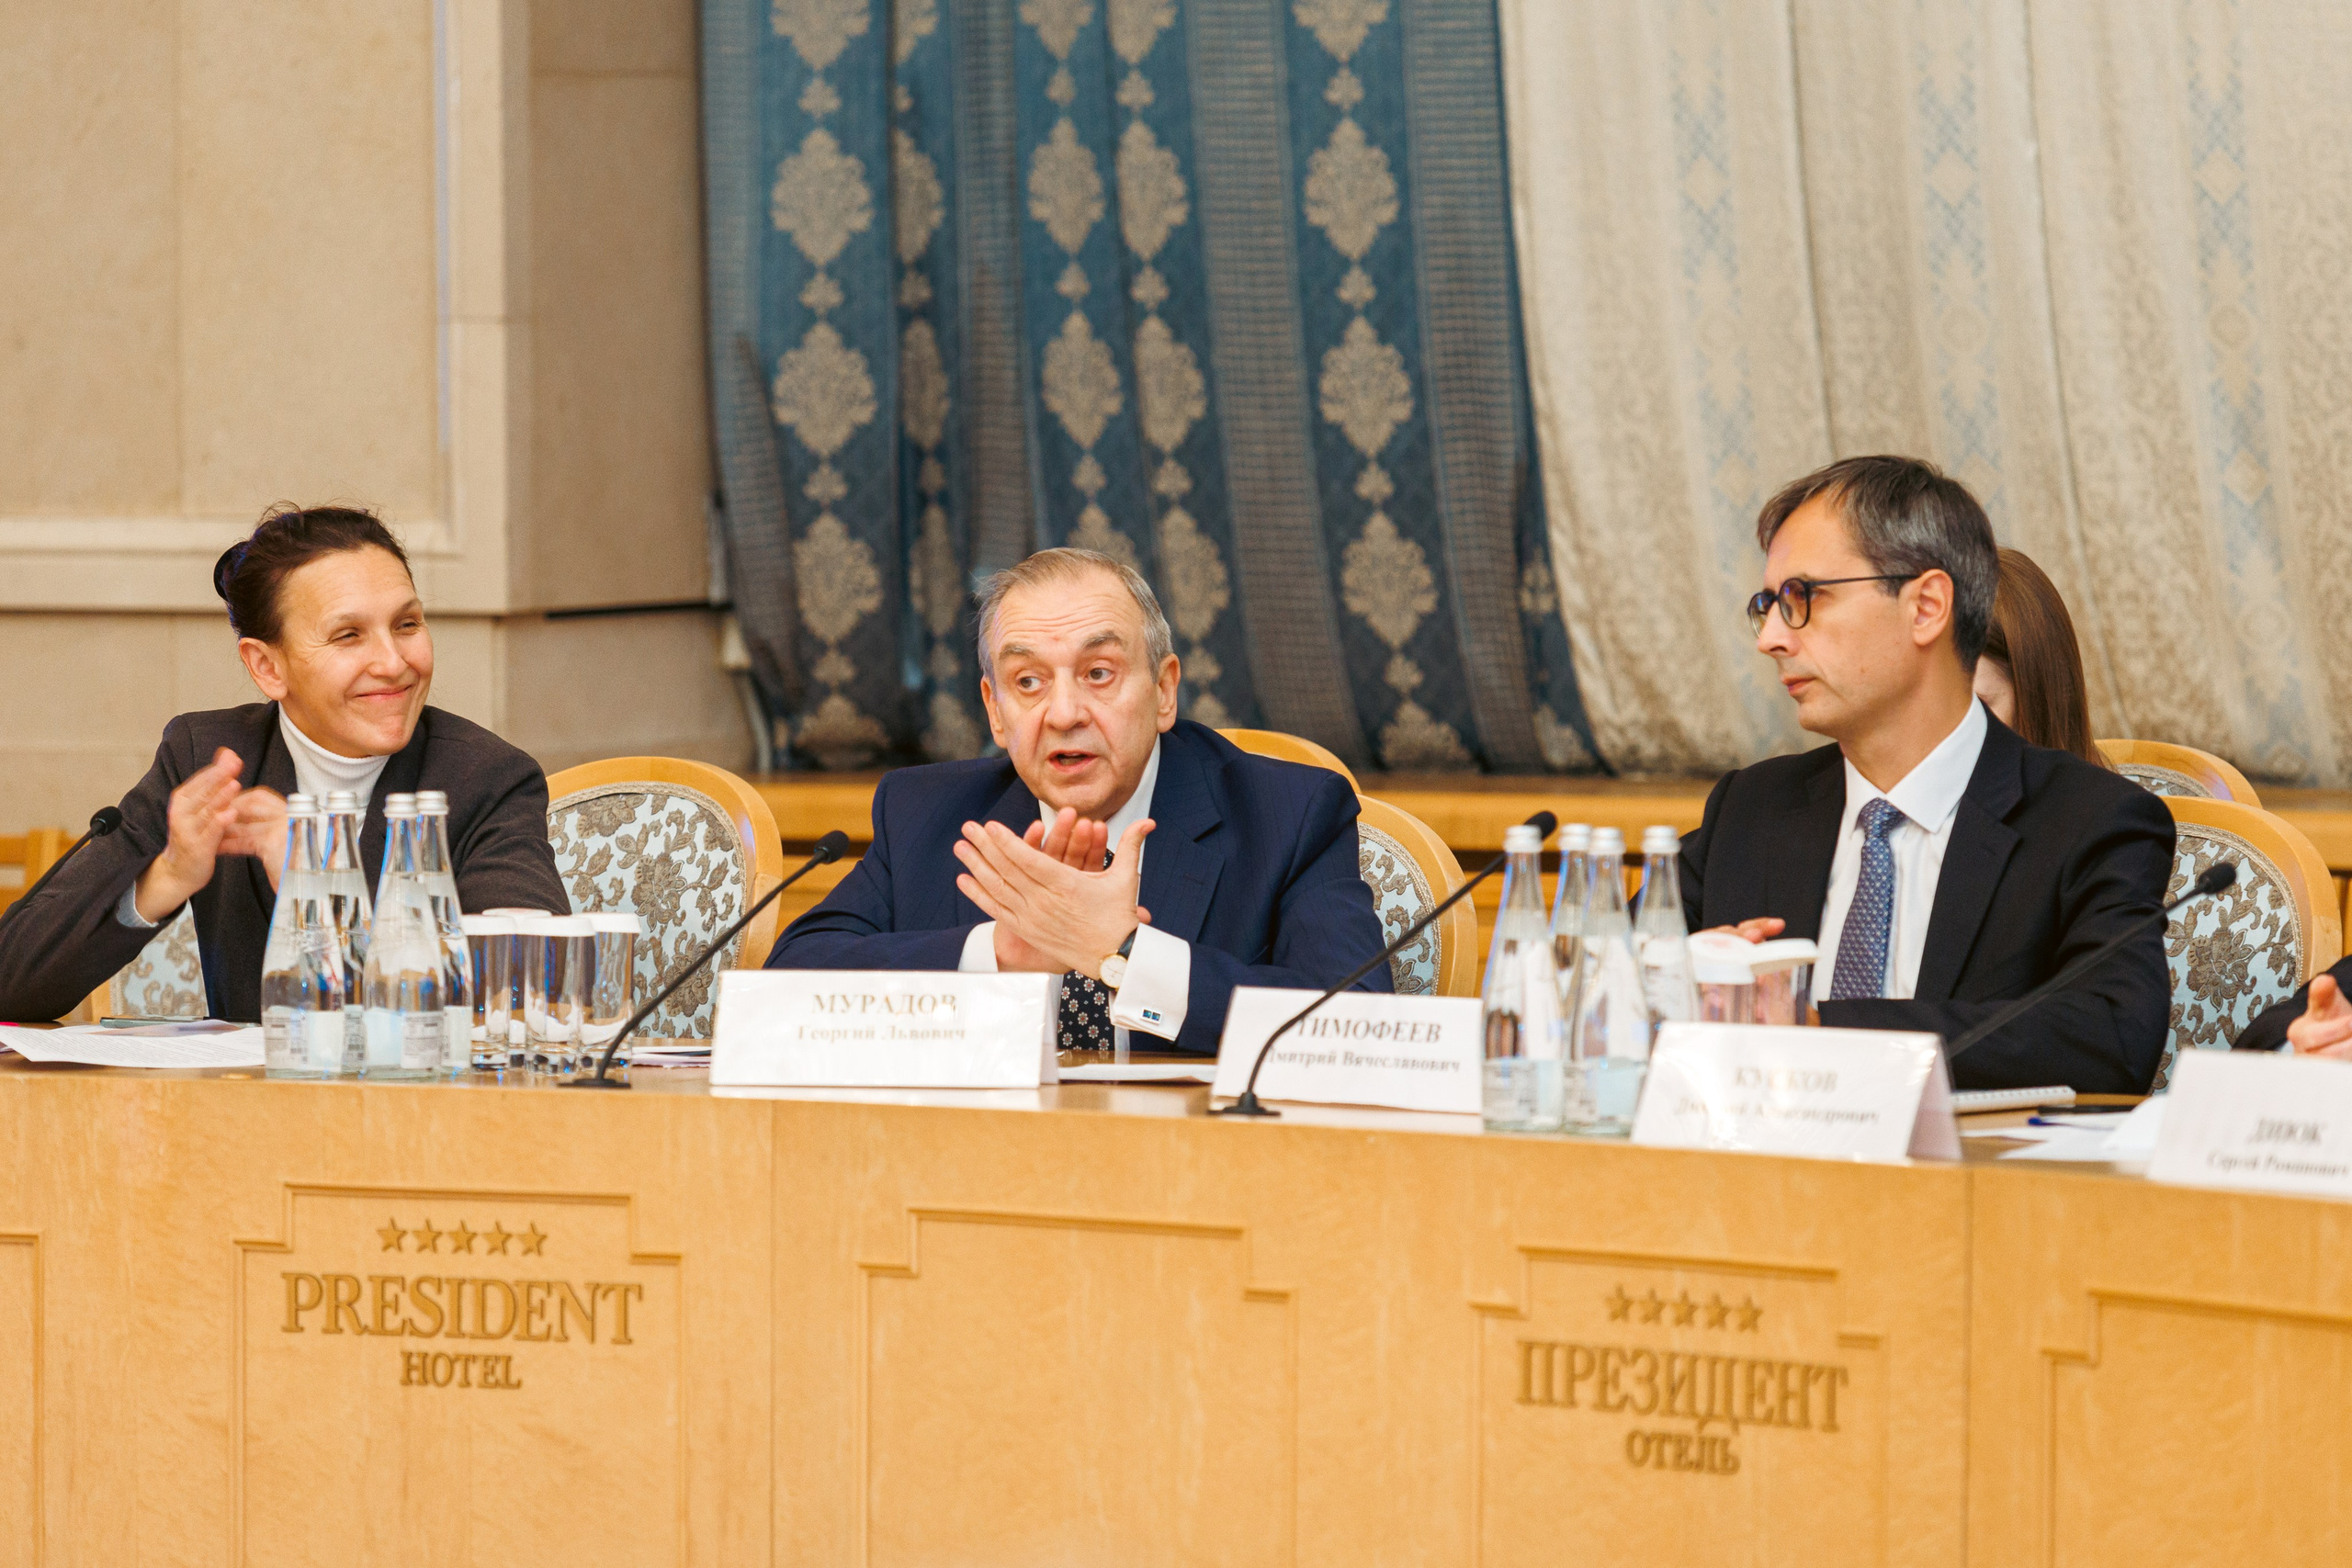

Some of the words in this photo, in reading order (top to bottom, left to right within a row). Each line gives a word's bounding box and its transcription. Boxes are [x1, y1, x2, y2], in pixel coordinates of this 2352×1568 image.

[811, 993, 957, 1017] МУРАДОВ
[797, 1025, 876, 1044] Георгий
[882, 1025, 966, 1040] Львович
[1342, 1052, 1460, 1073] Вячеславович
[280, 1271, 642, 1344] PRESIDENT
[399, 1351, 523, 1389] HOTEL
[1515, 1338, 1849, 1436] ПРЕЗИДЕНТ
[1625, 1429, 1741, 1475] ОТЕЛЬ
